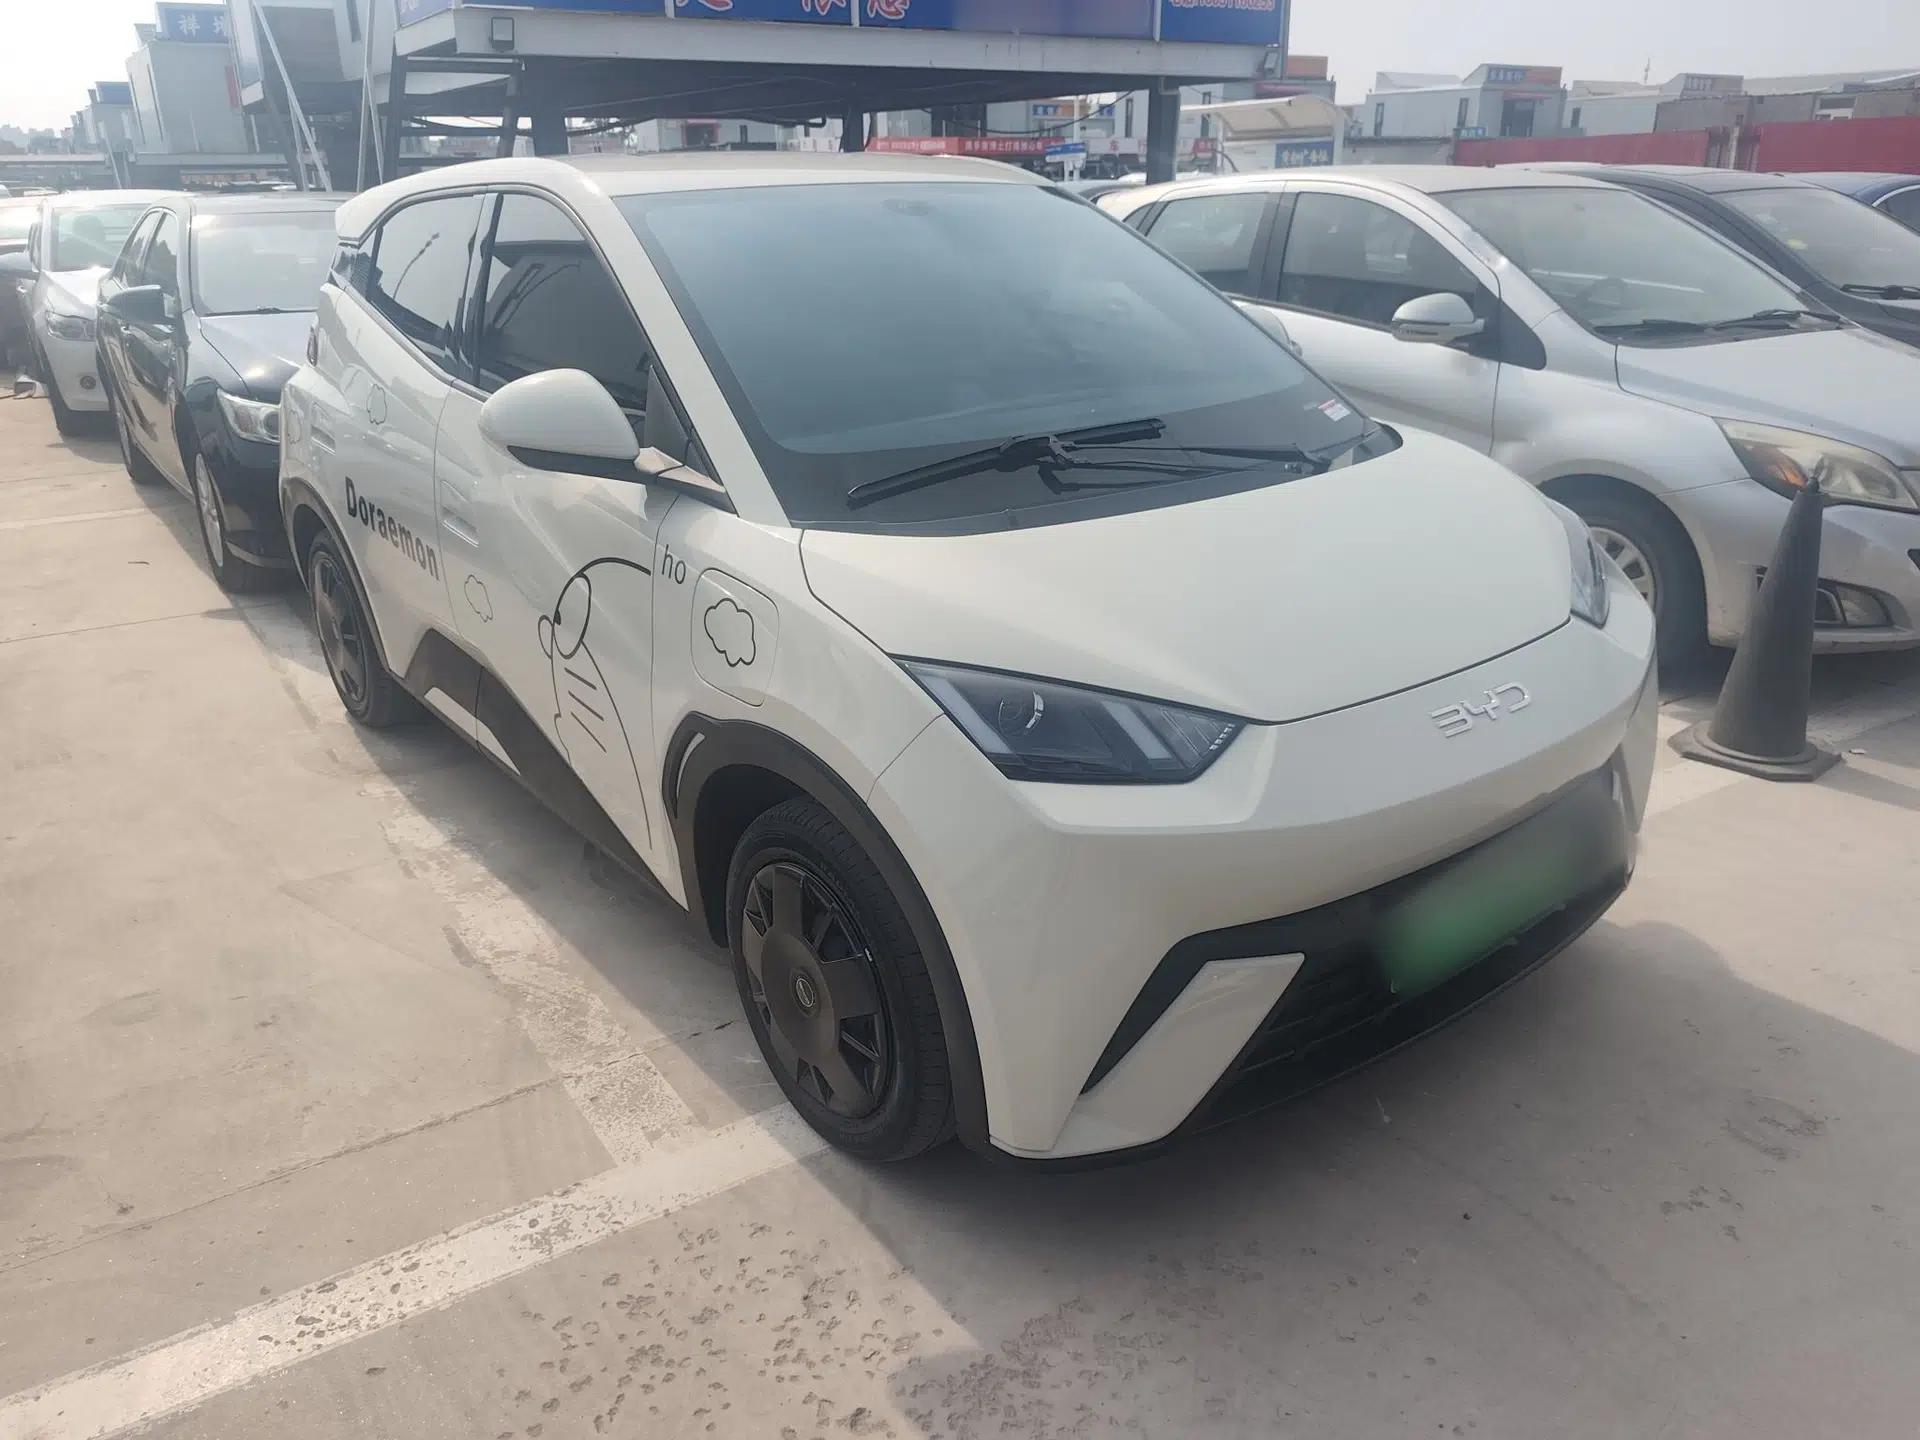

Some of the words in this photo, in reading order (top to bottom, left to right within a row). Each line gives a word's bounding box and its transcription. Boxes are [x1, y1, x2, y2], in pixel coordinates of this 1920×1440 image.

[345, 476, 440, 581] Doraemon
[661, 543, 686, 585] ho
[1431, 682, 1530, 739] BYD
